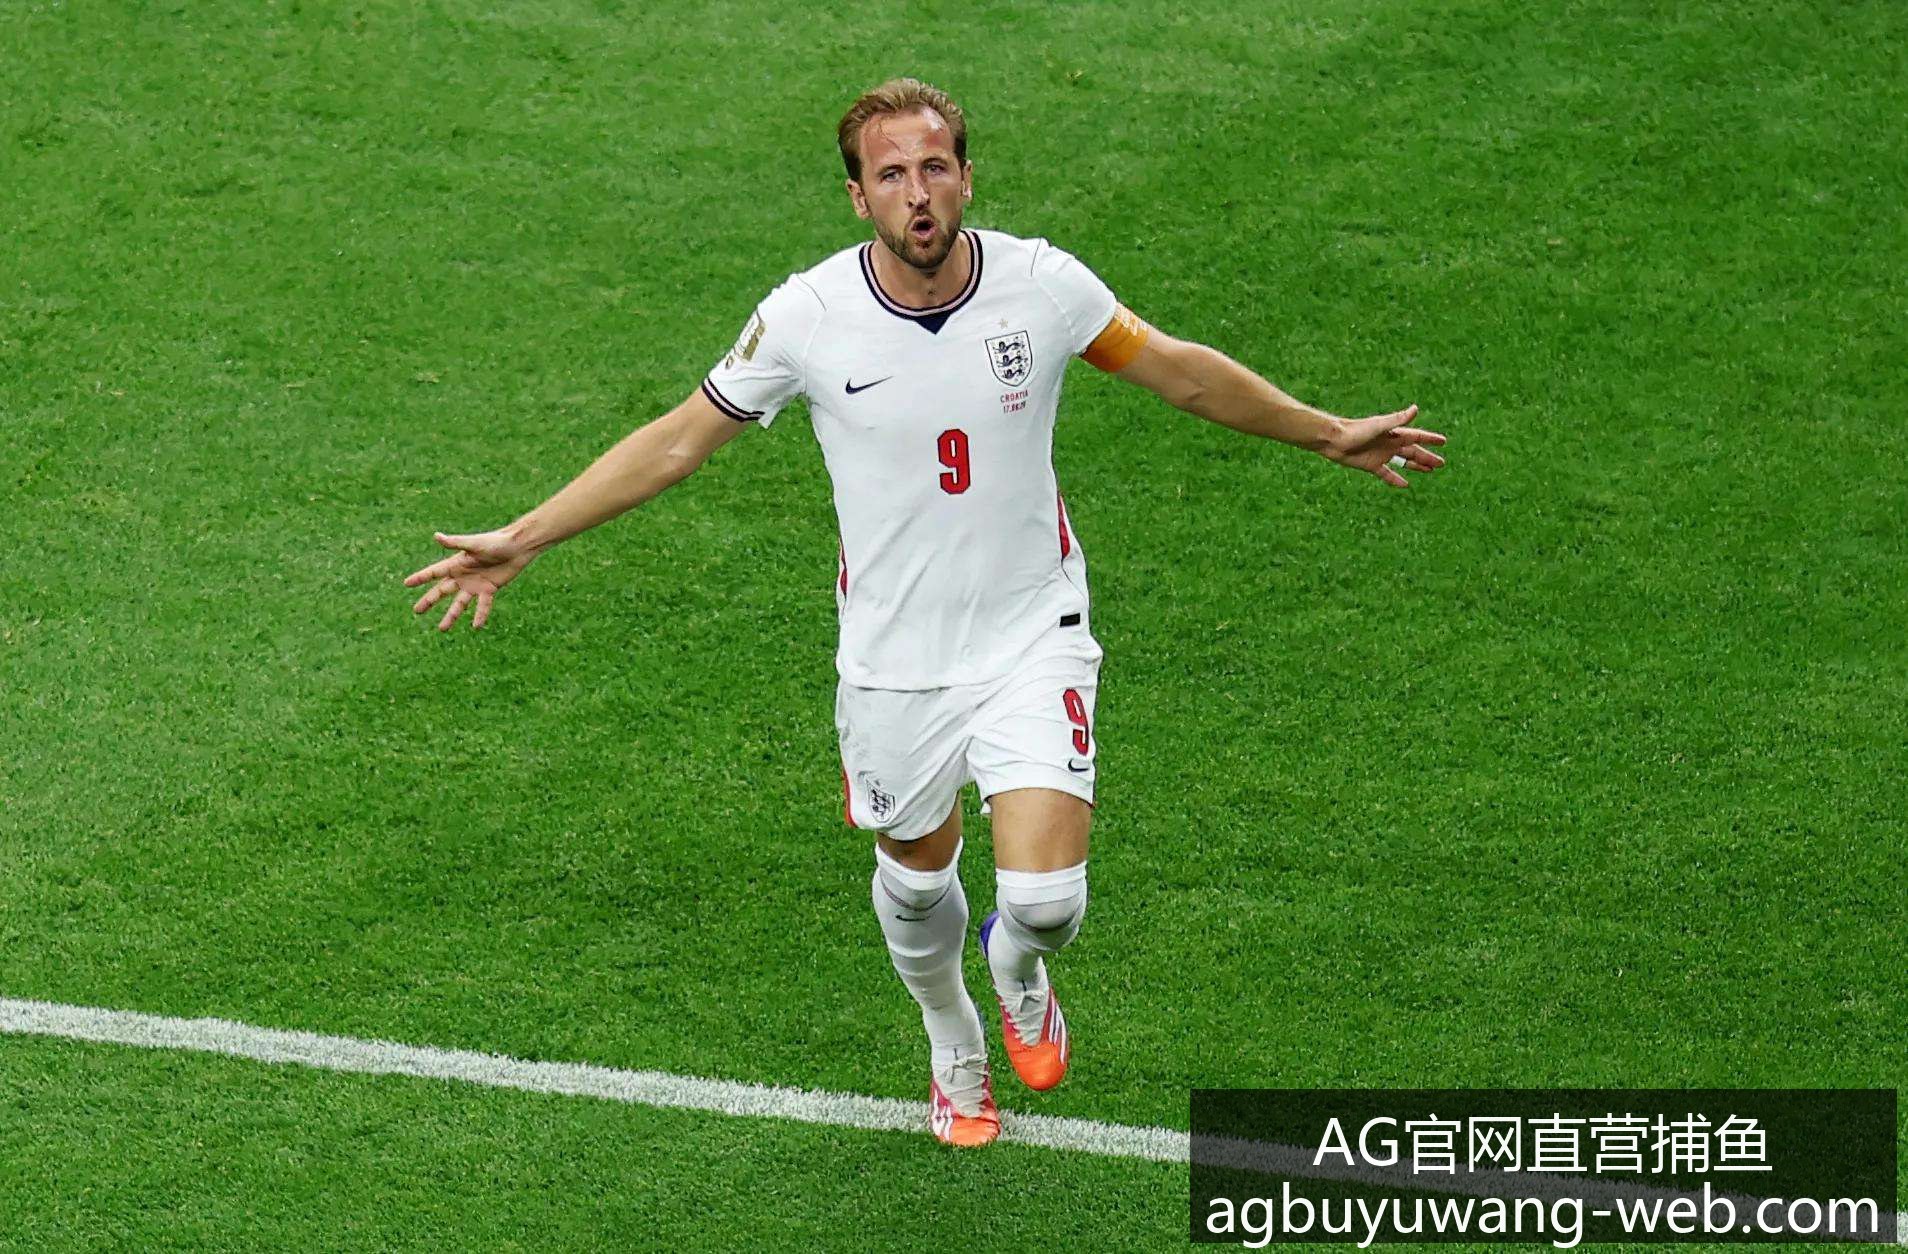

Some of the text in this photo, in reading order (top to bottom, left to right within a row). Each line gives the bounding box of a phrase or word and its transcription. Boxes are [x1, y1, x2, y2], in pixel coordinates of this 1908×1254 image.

[1000, 389, 1029, 404] CROATIA
[938, 429, 970, 494] 9
[1063, 689, 1090, 755] 9
